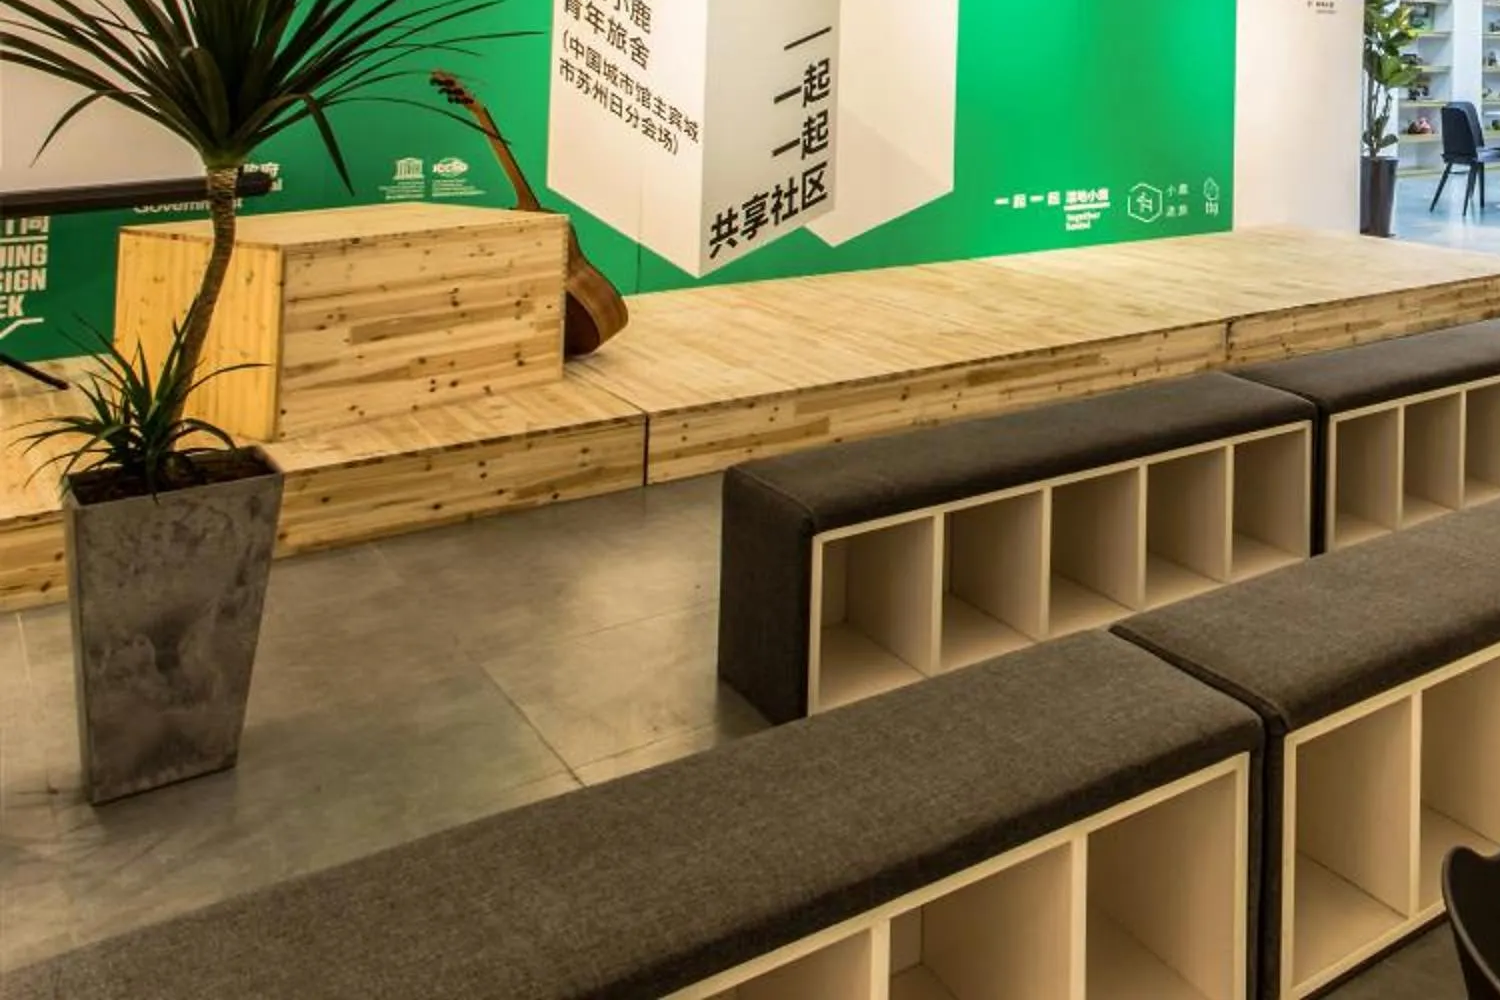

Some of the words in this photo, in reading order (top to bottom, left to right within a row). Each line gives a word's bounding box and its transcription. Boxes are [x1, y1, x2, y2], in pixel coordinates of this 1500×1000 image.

[773, 57, 831, 108] 一起
[771, 109, 829, 161] 一起
[709, 161, 828, 260] 共享社区
